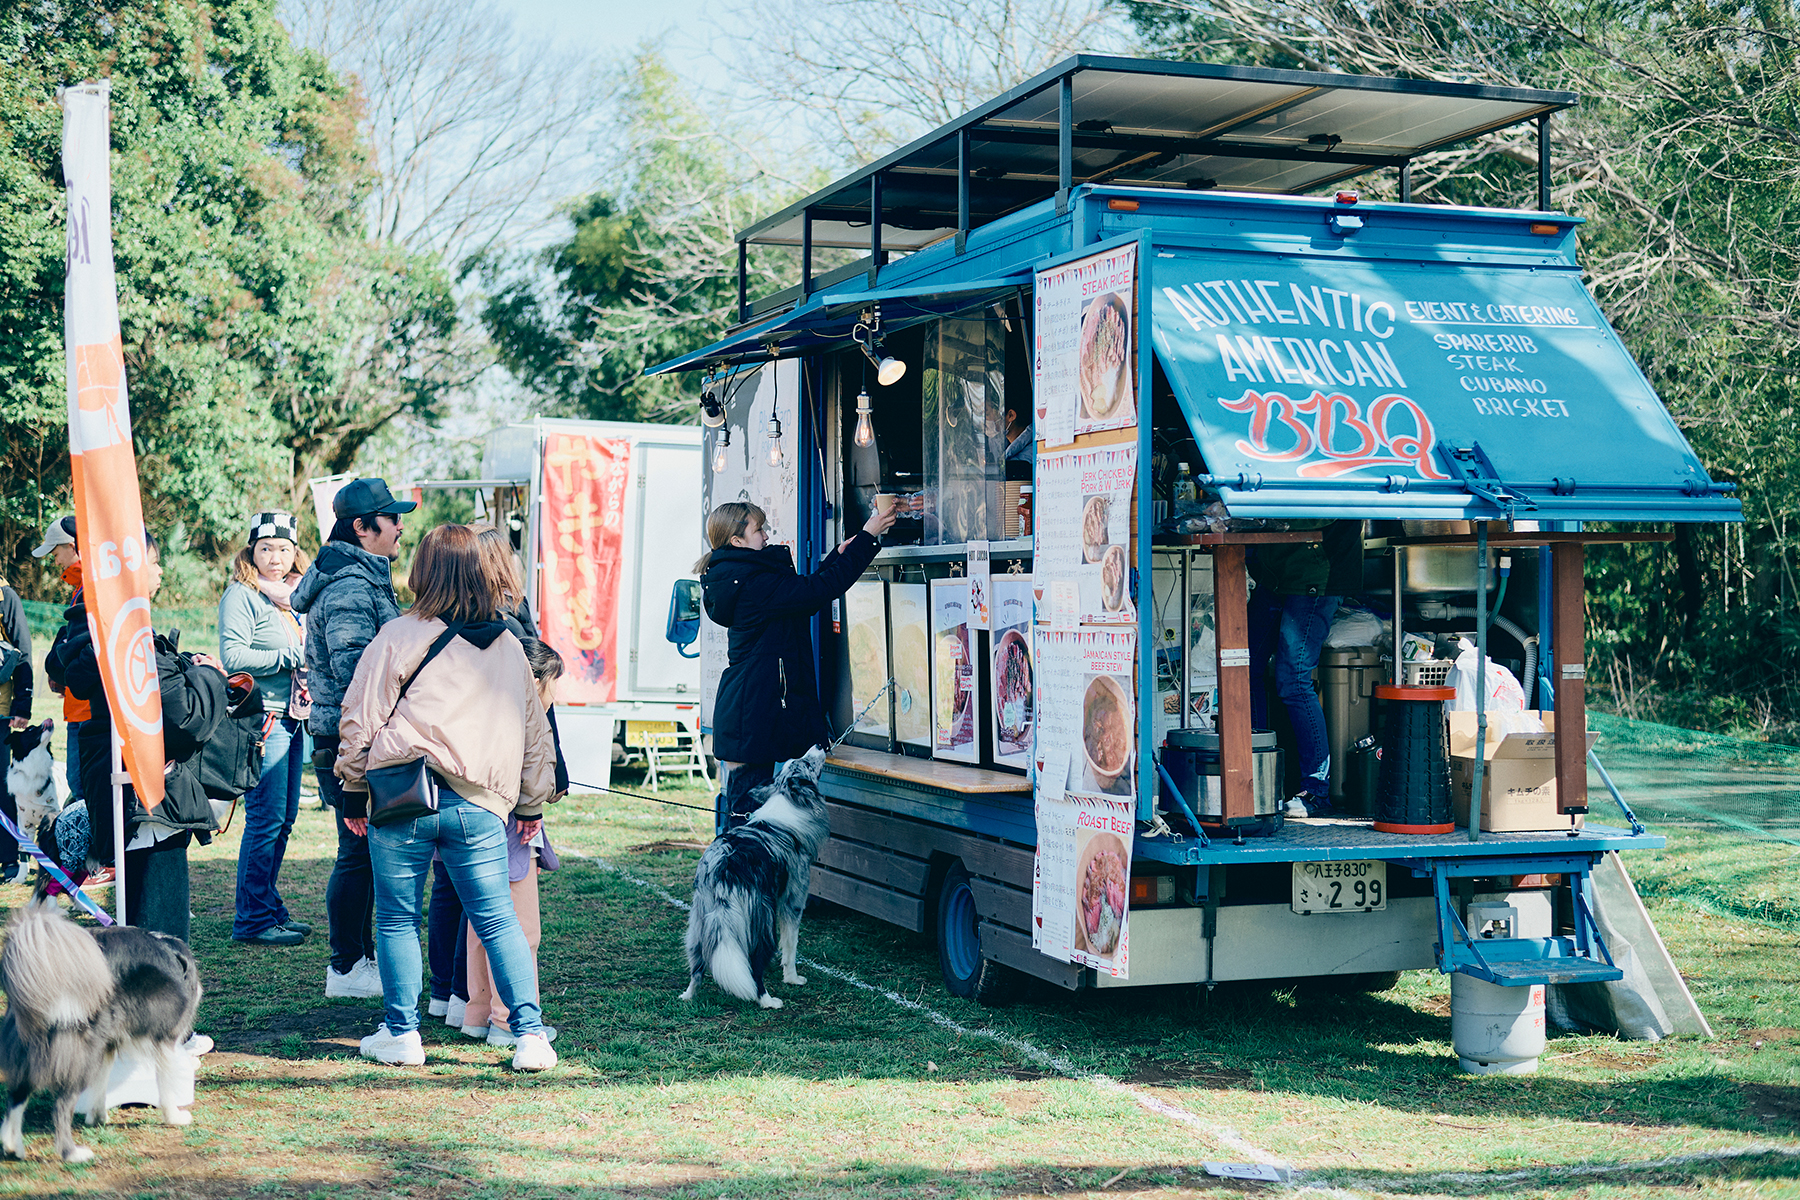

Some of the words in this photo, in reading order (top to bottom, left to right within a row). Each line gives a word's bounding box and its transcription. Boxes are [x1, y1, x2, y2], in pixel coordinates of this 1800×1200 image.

[1082, 280, 1109, 296] STEAK
[1110, 270, 1130, 287] RICE
[1162, 279, 1395, 338] AUTHENTIC
[1405, 300, 1467, 322] EVENT
[1488, 303, 1579, 325] CATERING
[1434, 333, 1538, 354] SPARERIB
[1215, 333, 1407, 389] AMERICAN
[1447, 354, 1523, 373] STEAK
[1460, 376, 1547, 395] CUBANO
[1471, 398, 1570, 419] BRISKET
[1217, 389, 1451, 480] BBQ
[1081, 471, 1096, 482] JERK
[1098, 469, 1126, 480] CHICKEN
[1081, 483, 1097, 493] PORK
[1105, 480, 1111, 490] W
[1115, 479, 1131, 490] JERK
[547, 436, 605, 650] やきいも
[1083, 649, 1112, 659] JAMAICAN
[1113, 651, 1131, 661] STYLE
[1091, 661, 1105, 671] BEEF
[1106, 662, 1123, 672] STEW
[1507, 787, 1551, 797] キムチの素
[1077, 811, 1108, 829] ROAST
[1111, 816, 1131, 834] BEEF
[1314, 863, 1367, 878] 八王子830
[1301, 889, 1309, 903] さ
